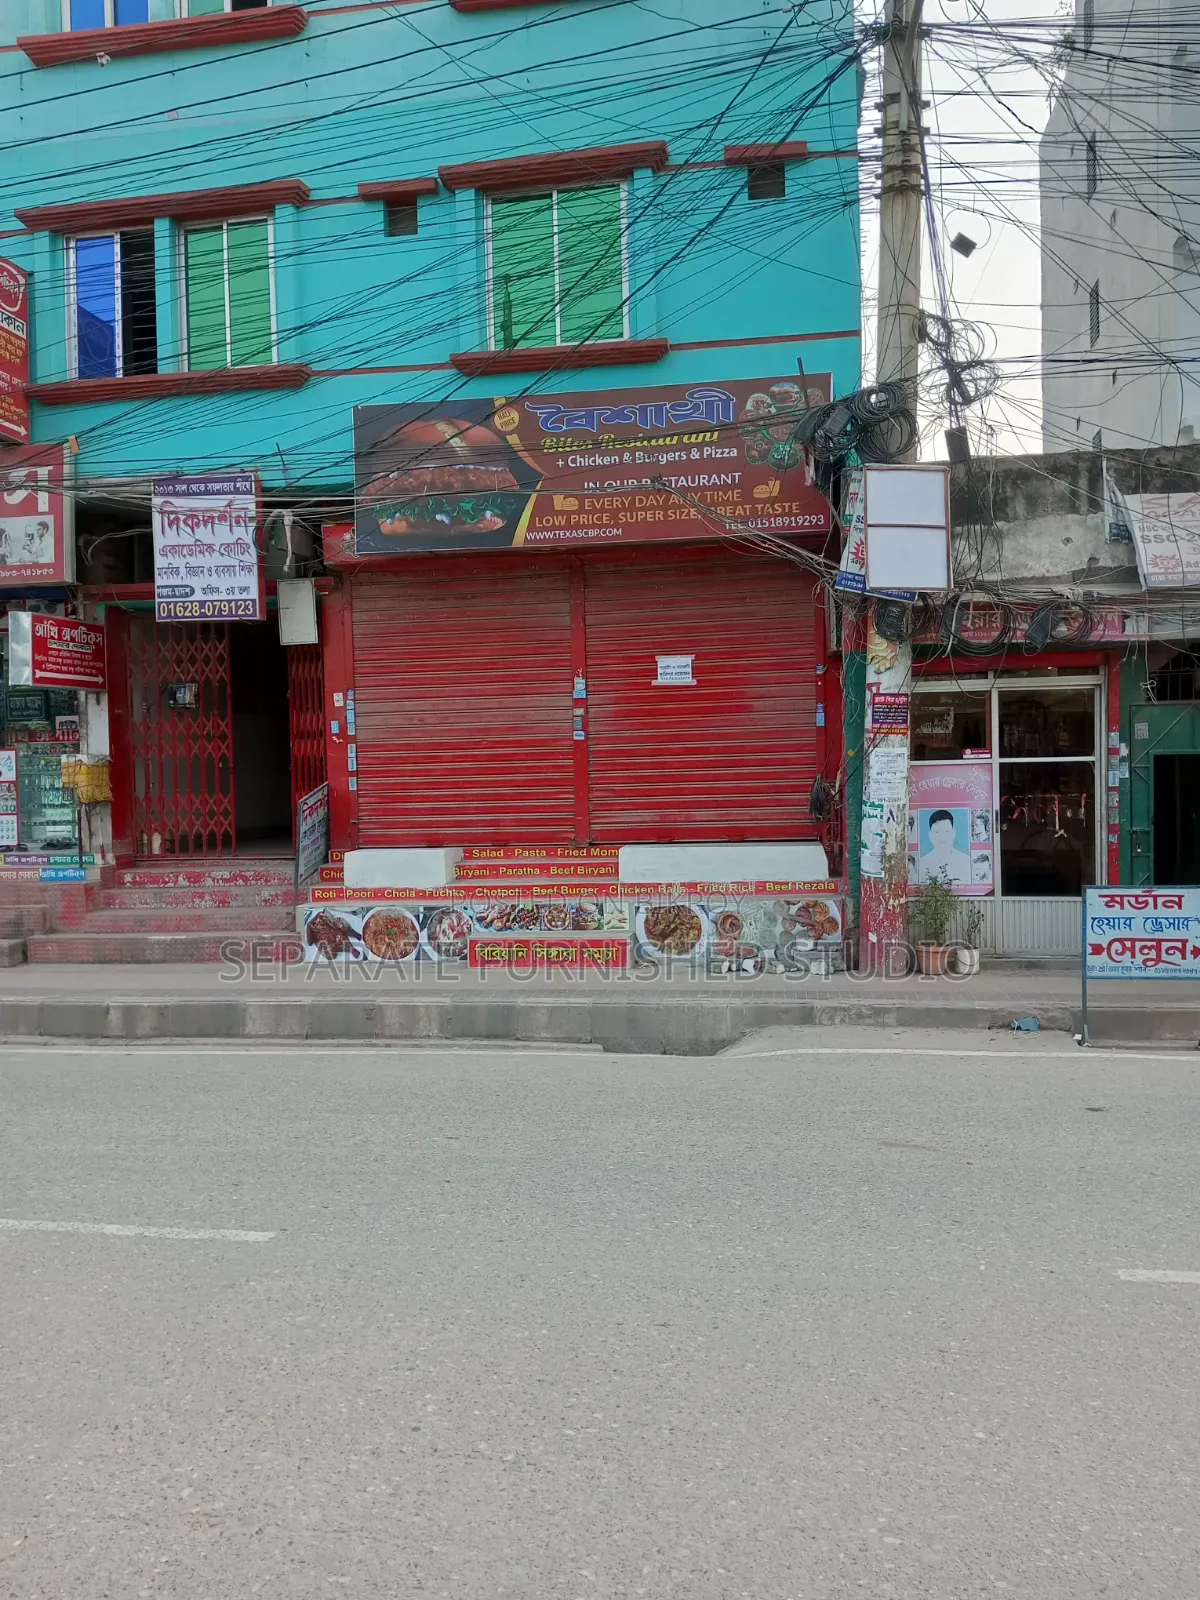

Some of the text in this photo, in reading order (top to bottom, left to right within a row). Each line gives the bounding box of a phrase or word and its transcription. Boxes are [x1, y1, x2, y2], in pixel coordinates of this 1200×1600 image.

[498, 410, 511, 420] HALF
[525, 387, 735, 432] বৈশাখী
[500, 417, 516, 429] PRICE
[568, 454, 619, 468] Chicken
[622, 452, 633, 464] &
[636, 448, 687, 465] Burgers
[690, 447, 700, 459] &
[703, 445, 738, 459] Pizza
[155, 478, 251, 495] ২০১৩ সাল থেকে সফলতার শীর্ষে
[642, 472, 742, 491] RSTAURANT
[584, 497, 632, 511] EVERY
[635, 495, 665, 508] DAY
[703, 489, 742, 503] TIME
[159, 499, 249, 538] দিকদর্শন
[535, 515, 566, 528] LOW
[570, 512, 614, 526] PRICE,
[618, 510, 665, 523] SUPER
[670, 508, 701, 521] SIZE,
[756, 502, 800, 515] TASTE
[748, 514, 824, 528] 01518919293
[526, 527, 622, 541] WWW.TEXASCBP.COM
[159, 537, 253, 560] একাডেমিক কোচিং
[157, 562, 255, 580] মানবিক, বিজ্ঞান ও ব্যবসায় শিক্ষা
[238, 586, 251, 596] তলা
[160, 600, 253, 617] 01628-079123
[34, 620, 59, 639] আঁখি
[919, 777, 940, 791] হেয়ার
[473, 848, 503, 858] Salad
[515, 848, 547, 857] Pasta
[557, 847, 587, 856] Fried
[500, 866, 540, 875] Paratha
[550, 865, 574, 875] Beef
[577, 864, 615, 878] Biryani
[315, 881, 835, 898] Roti Poori Chola Fuchka Chotpoti Beef Burger Chicken Balls Fried Rice Beef Rezala
[1091, 916, 1193, 935] হেয়ার ড্রেসার
[474, 943, 528, 962] বিরিয়ানি
[582, 946, 618, 965] সমুচা
[1106, 937, 1189, 967] সেলুন
